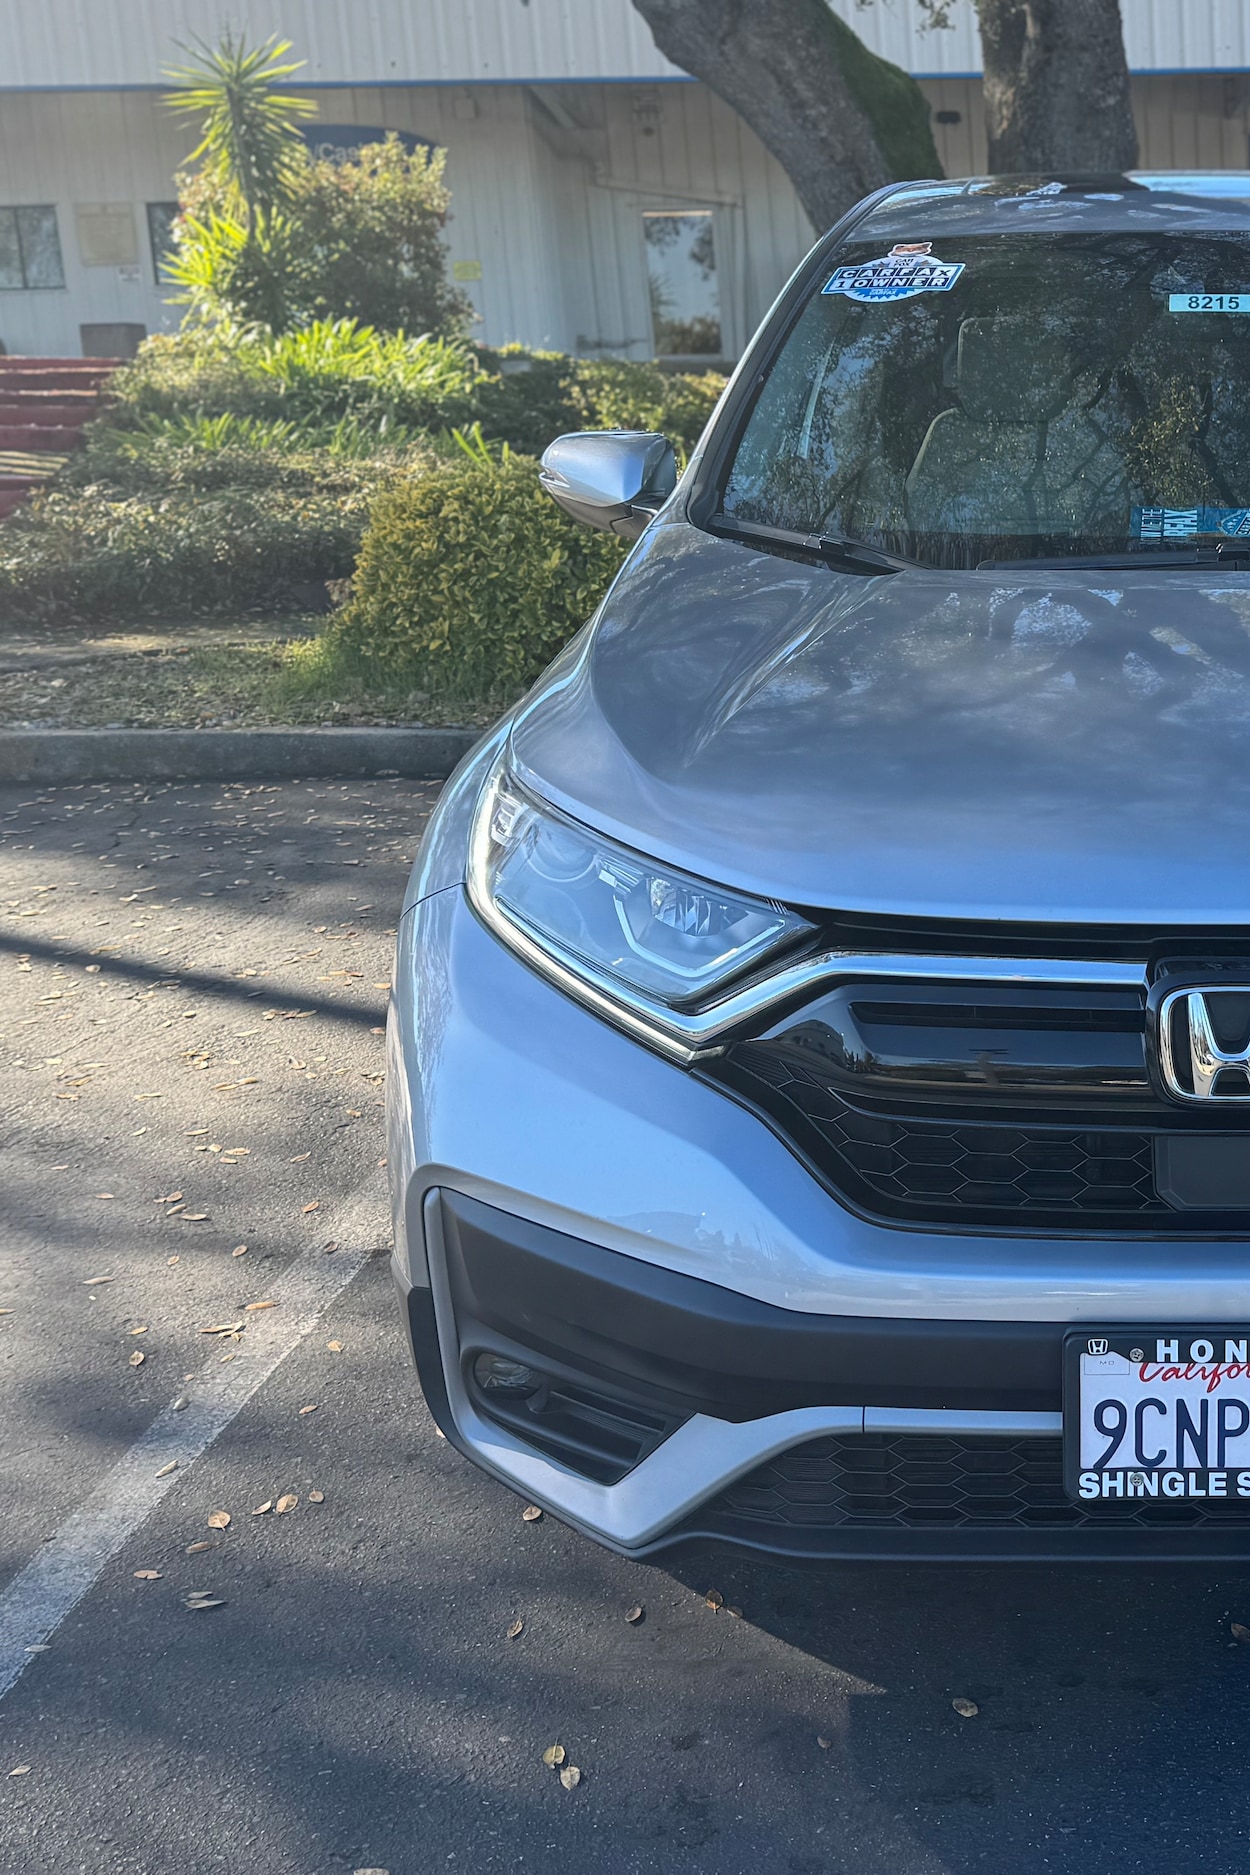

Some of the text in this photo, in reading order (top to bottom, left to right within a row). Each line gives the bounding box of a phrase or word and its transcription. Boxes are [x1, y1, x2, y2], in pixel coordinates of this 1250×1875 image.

[842, 267, 951, 278] CARFAX
[834, 280, 847, 289] 1
[853, 278, 947, 288] OWNER
[1188, 296, 1240, 309] 8215
[1078, 1471, 1228, 1499] SHINGLE
